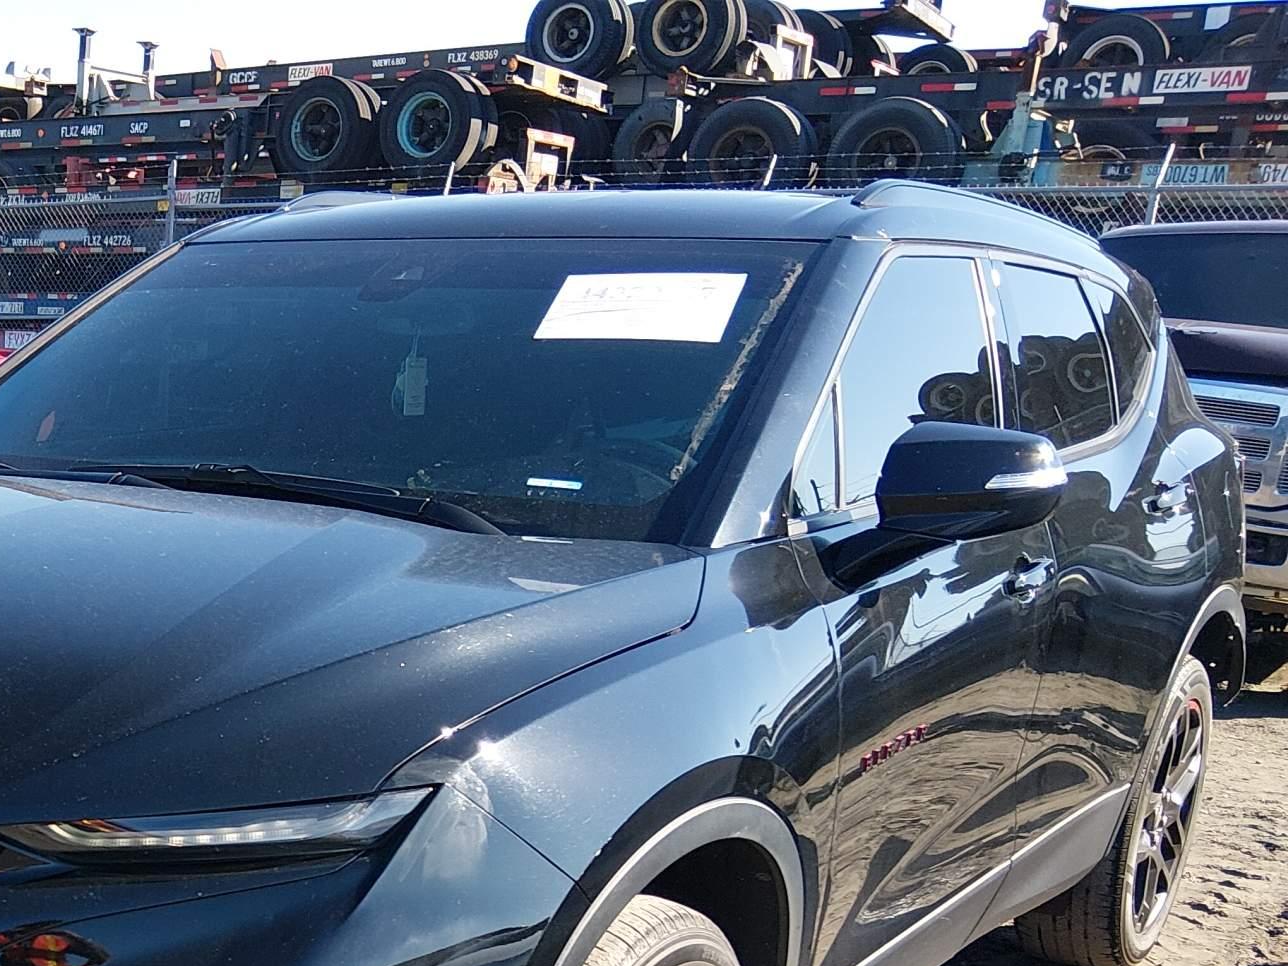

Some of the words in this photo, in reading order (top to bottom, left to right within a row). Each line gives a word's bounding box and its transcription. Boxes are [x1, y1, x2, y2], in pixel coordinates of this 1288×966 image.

[448, 53, 467, 63] FLXZ
[470, 50, 499, 62] 438369
[289, 65, 331, 80] FLEXI-VAN
[1156, 70, 1249, 90] FLEXI-VAN
[61, 127, 79, 137] FLXZ
[130, 122, 148, 134] SACP
[175, 190, 220, 205] FLEXI-VA
